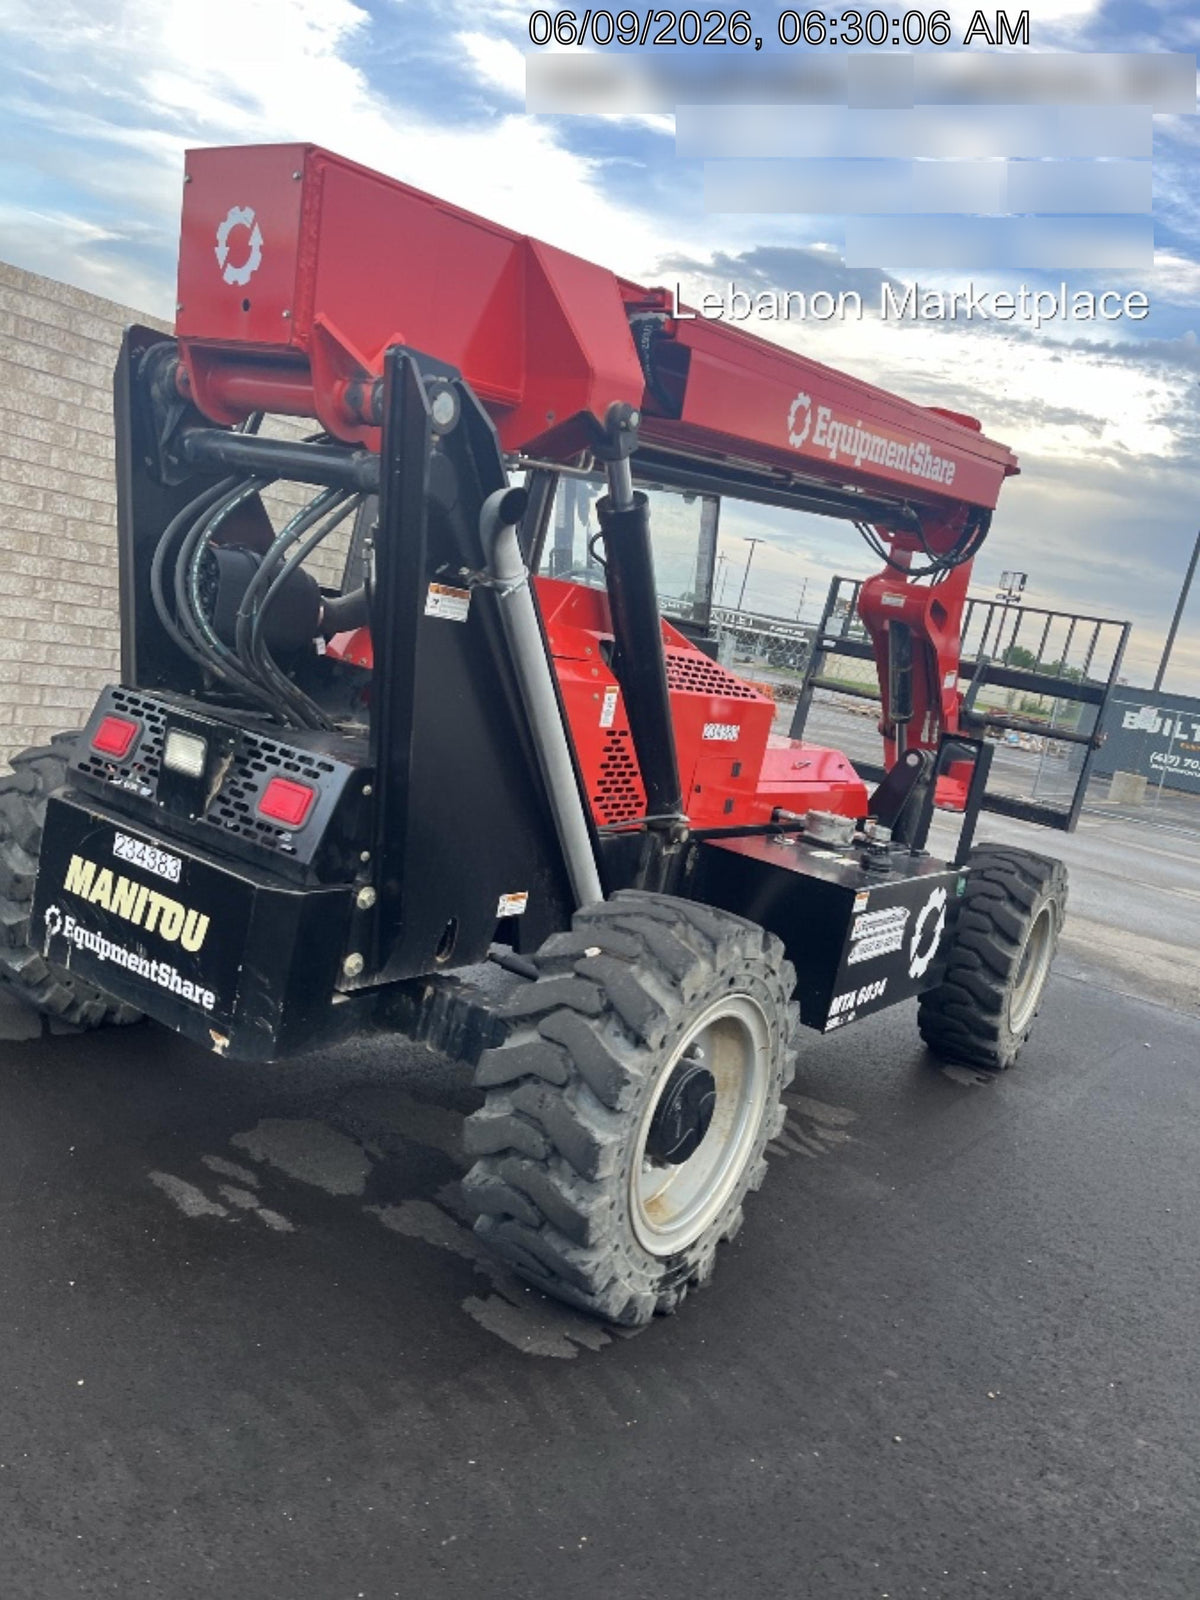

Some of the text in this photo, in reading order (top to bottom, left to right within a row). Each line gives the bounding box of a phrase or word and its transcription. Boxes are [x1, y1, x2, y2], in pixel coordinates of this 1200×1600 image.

[812, 405, 957, 486] EquipmentShare
[114, 834, 180, 880] 234383
[63, 854, 210, 953] MANITOU
[61, 914, 216, 1010] EquipmentShare
